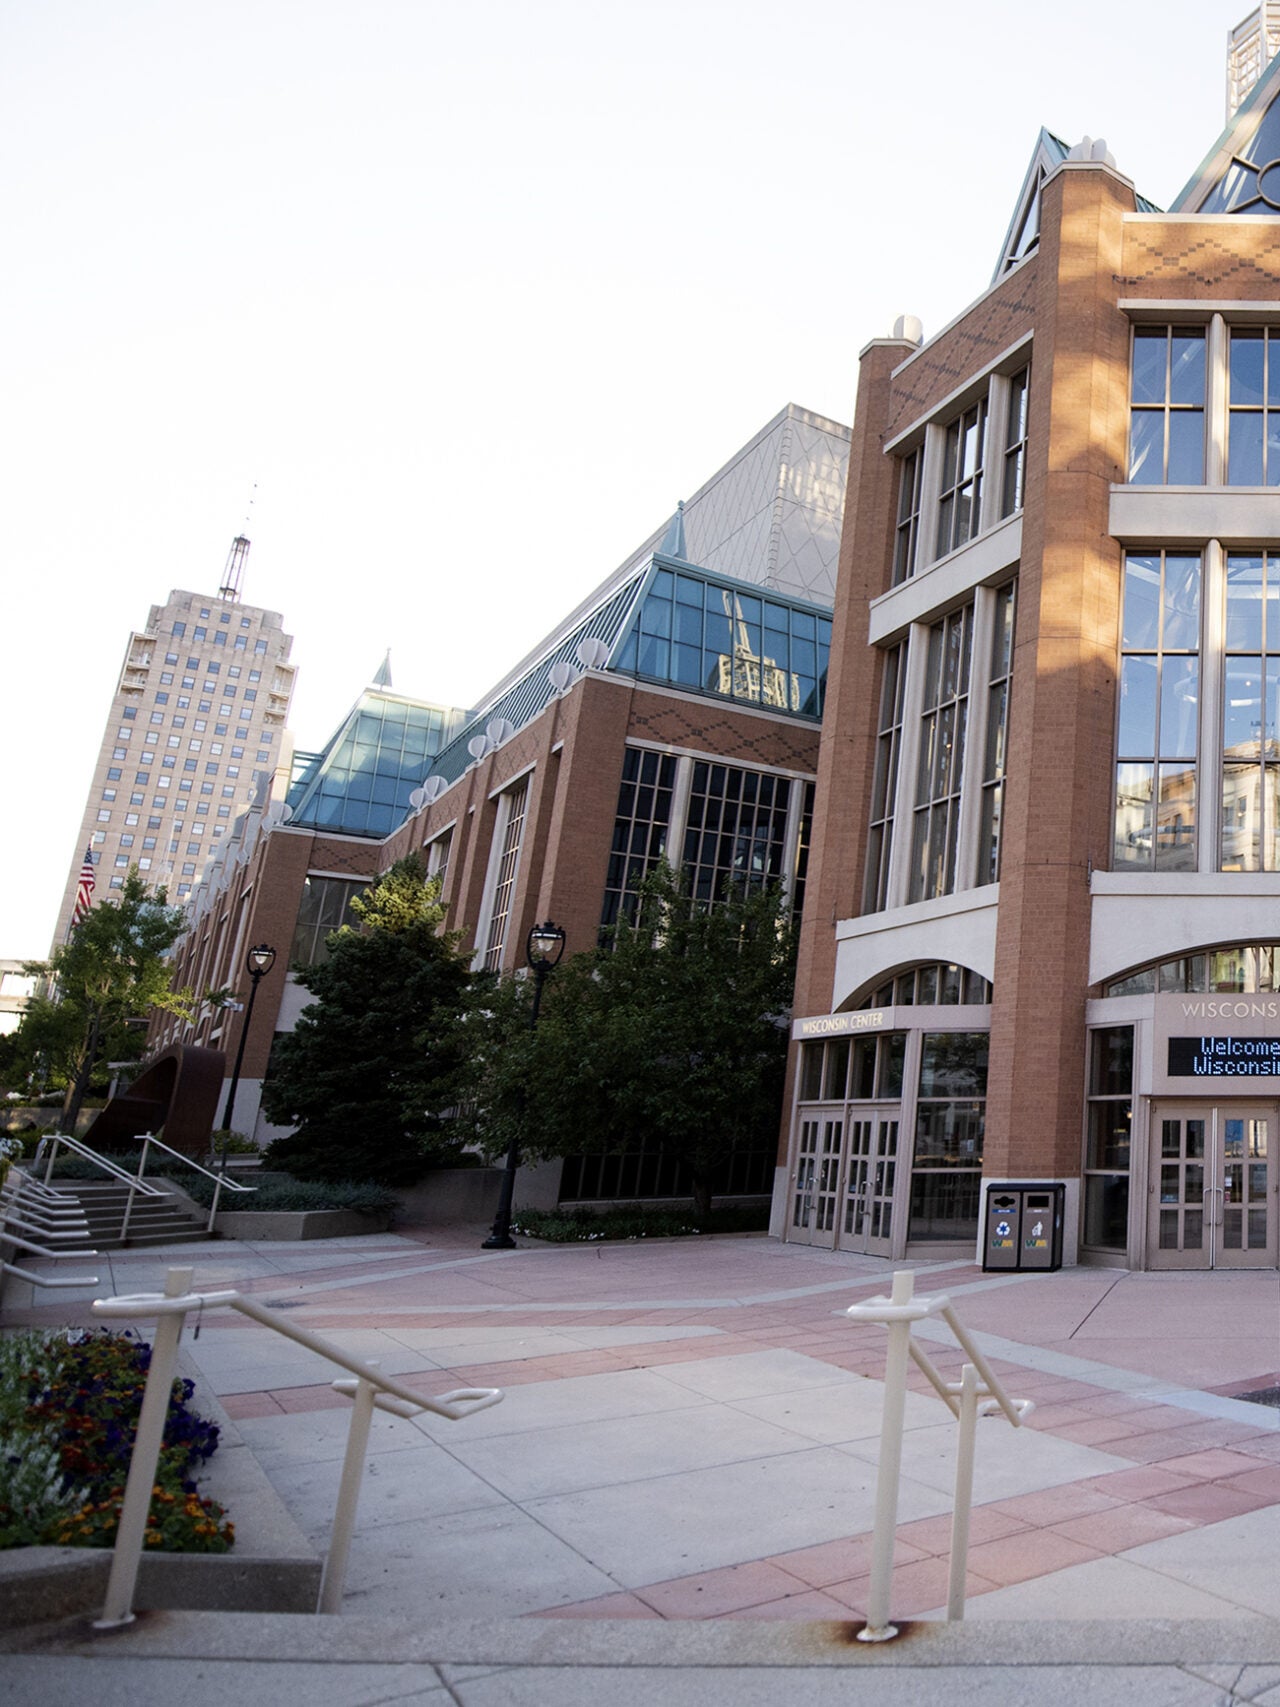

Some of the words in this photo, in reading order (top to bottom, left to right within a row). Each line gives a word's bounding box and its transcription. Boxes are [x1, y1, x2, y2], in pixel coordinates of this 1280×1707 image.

[802, 1017, 848, 1034] WISCONSIN
[850, 1012, 883, 1029] CENTER
[1201, 1037, 1280, 1055] Welcome
